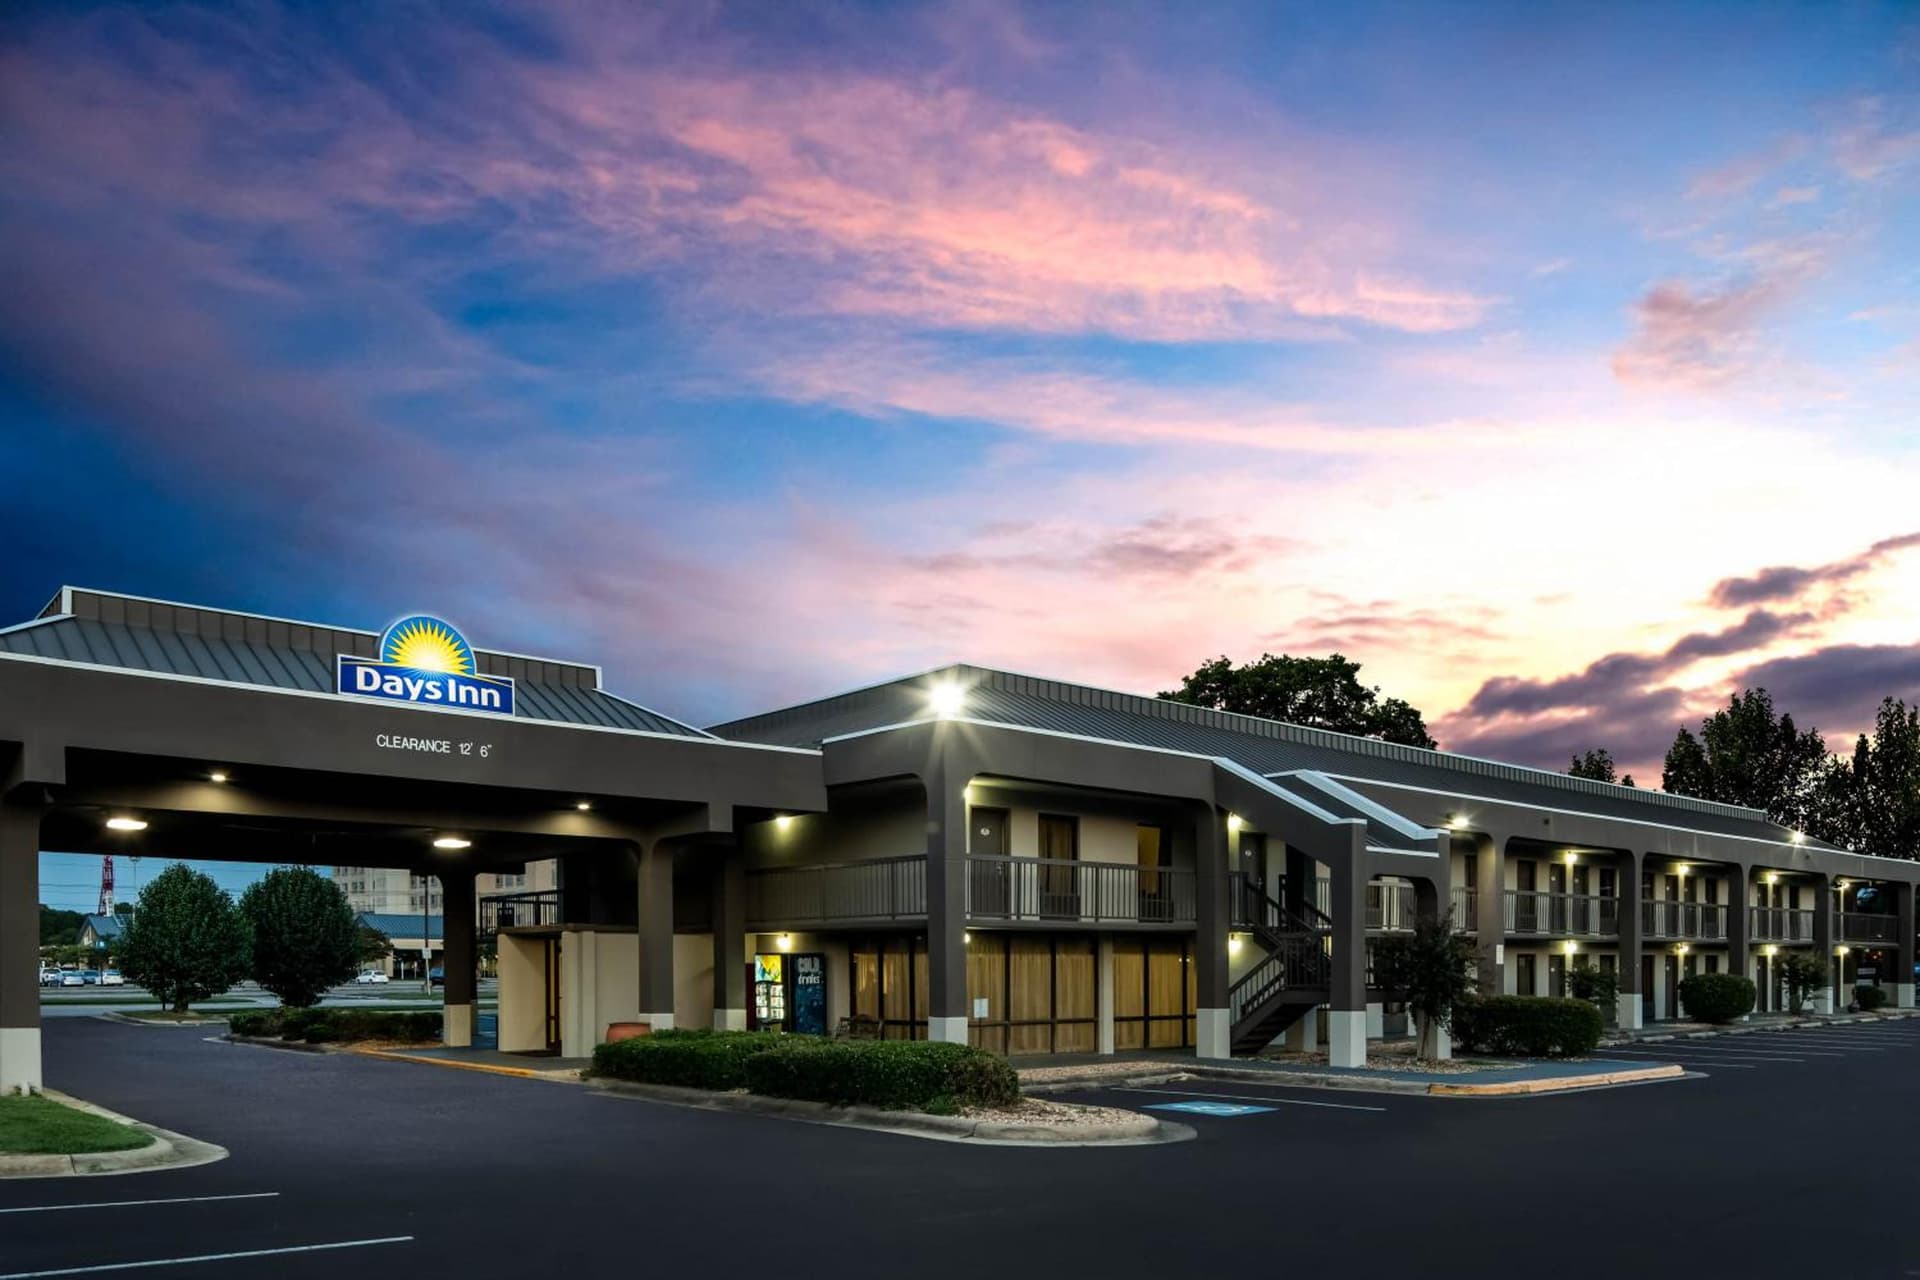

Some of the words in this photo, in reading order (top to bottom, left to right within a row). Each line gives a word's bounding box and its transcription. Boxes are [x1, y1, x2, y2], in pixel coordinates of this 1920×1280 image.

[356, 666, 443, 701] Days
[447, 679, 501, 708] Inn
[376, 734, 451, 754] CLEARANCE
